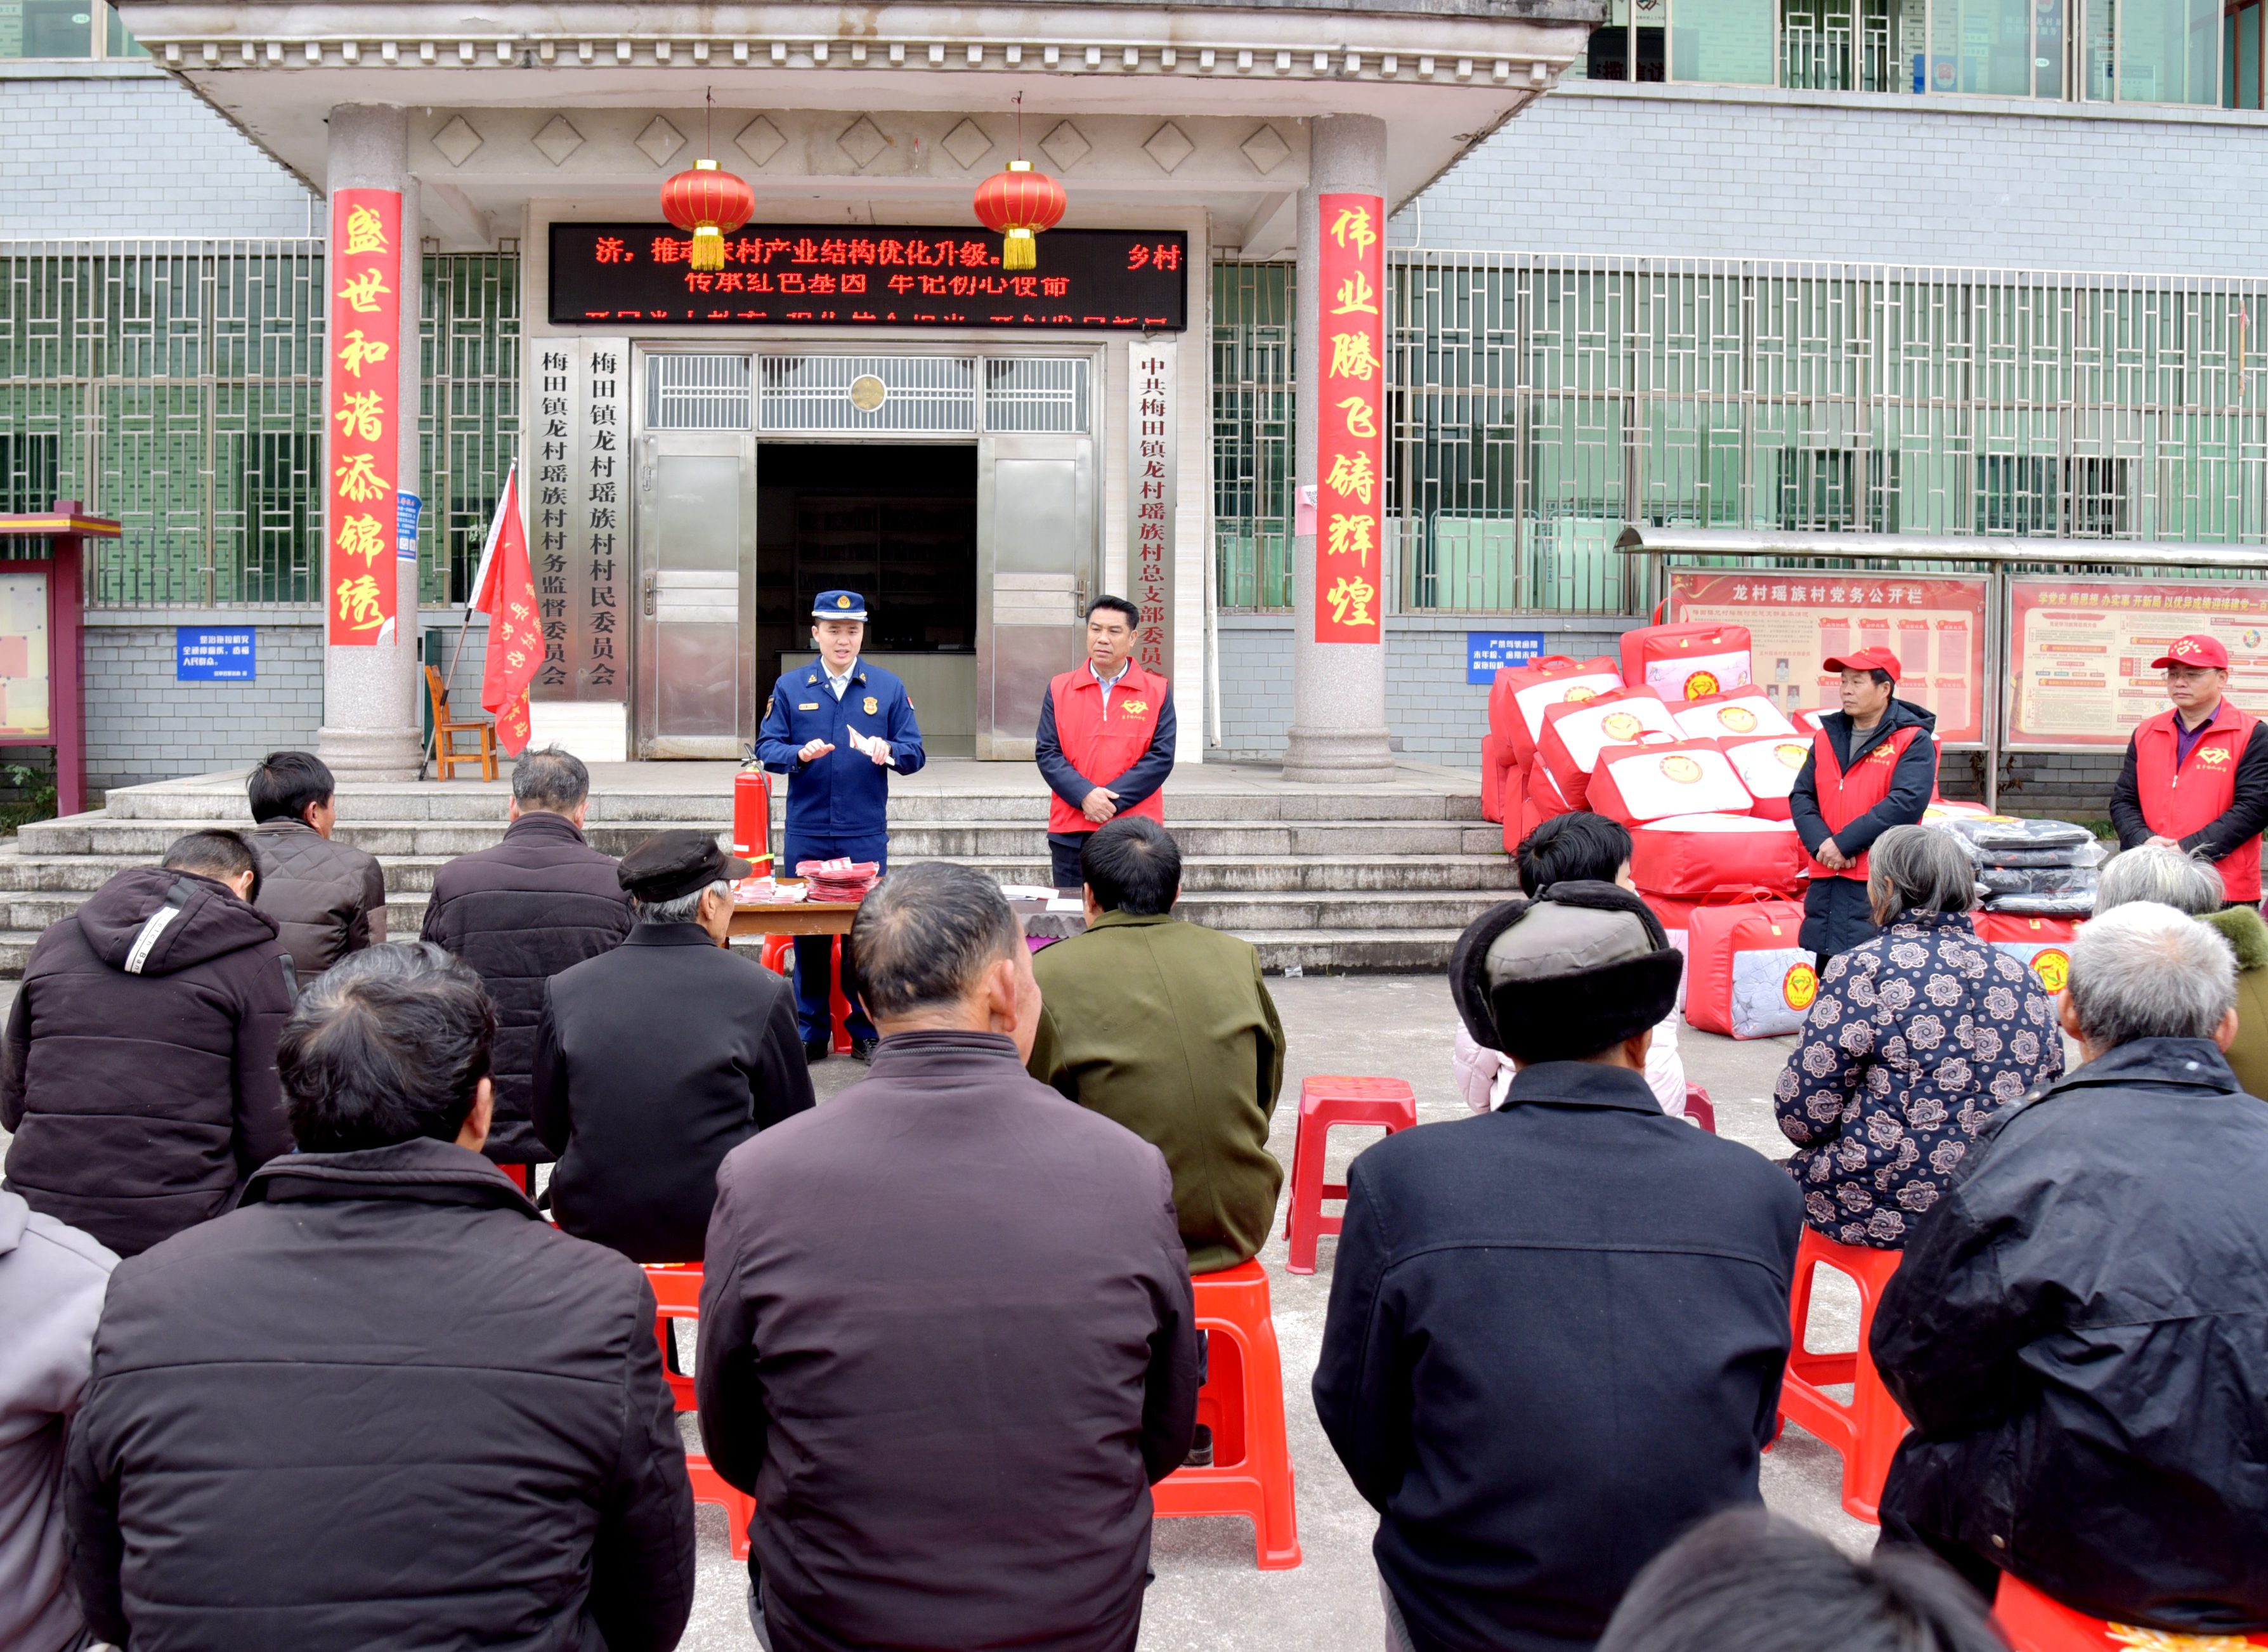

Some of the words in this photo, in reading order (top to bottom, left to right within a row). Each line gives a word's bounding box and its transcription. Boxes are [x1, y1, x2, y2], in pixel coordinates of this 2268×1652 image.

[334, 204, 391, 631] 盛世和谐添锦绣
[540, 351, 568, 686] 梅田镇龙村瑶族村村务监督委员会
[588, 351, 617, 686] 梅田镇龙村瑶族村村民委员会
[1138, 356, 1166, 677] 中共梅田镇龙村瑶族村总支部委员
[1325, 205, 1380, 627] 伟业腾飞铸辉煌
[1732, 584, 1923, 605] 龙村瑶族村党务公开栏
[2038, 591, 2067, 605] 学党史
[2101, 593, 2131, 607] 办实事
[2133, 594, 2161, 609] 开新局
